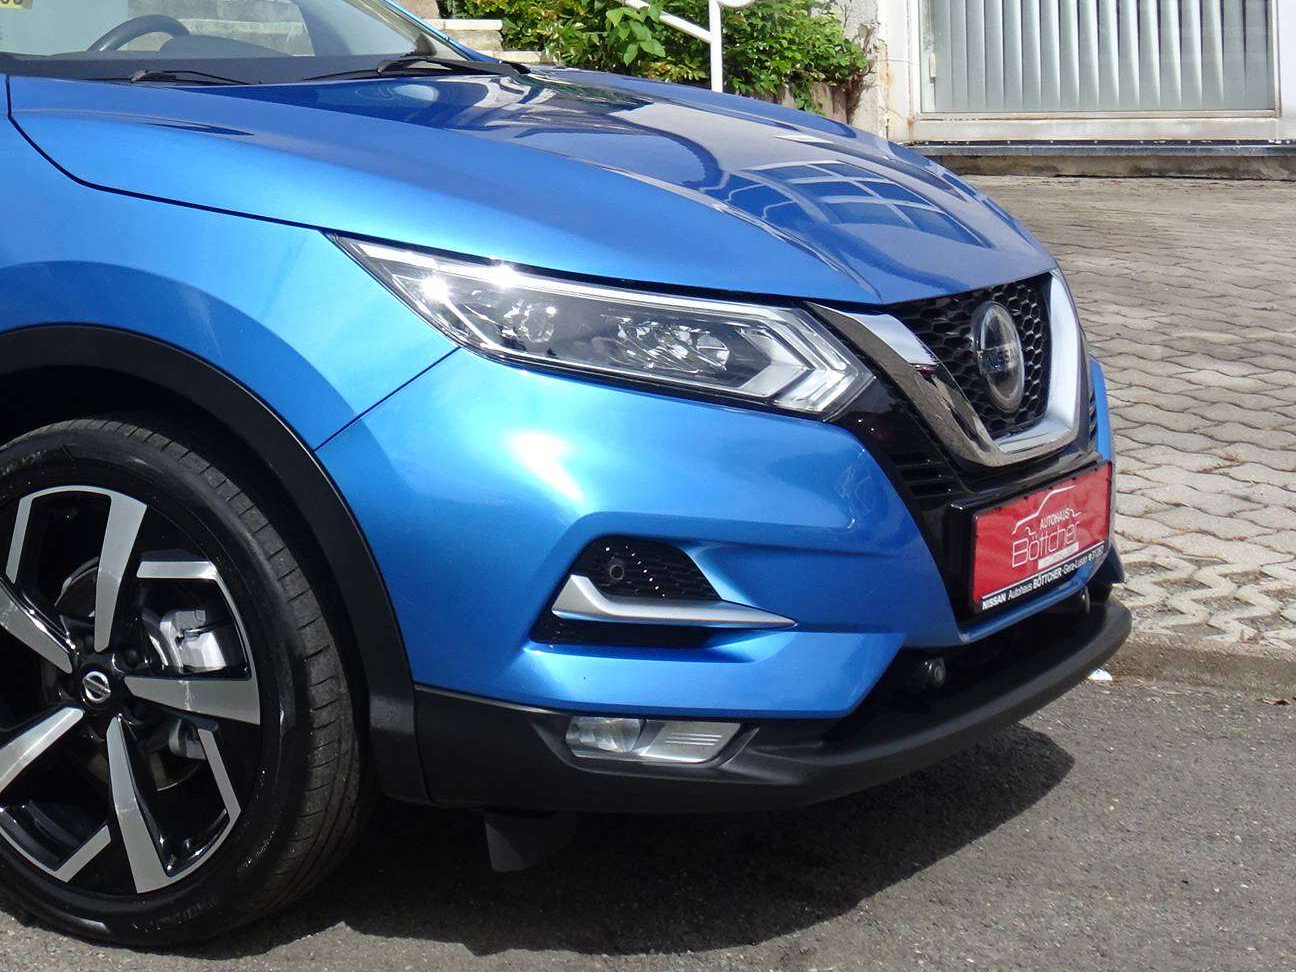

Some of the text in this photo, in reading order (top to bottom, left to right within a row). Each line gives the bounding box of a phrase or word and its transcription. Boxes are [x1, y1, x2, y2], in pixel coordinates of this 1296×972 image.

[1040, 508, 1070, 530] AUTOHAUS
[1012, 521, 1081, 568] Böttcher
[982, 593, 1007, 611] NISSAN
